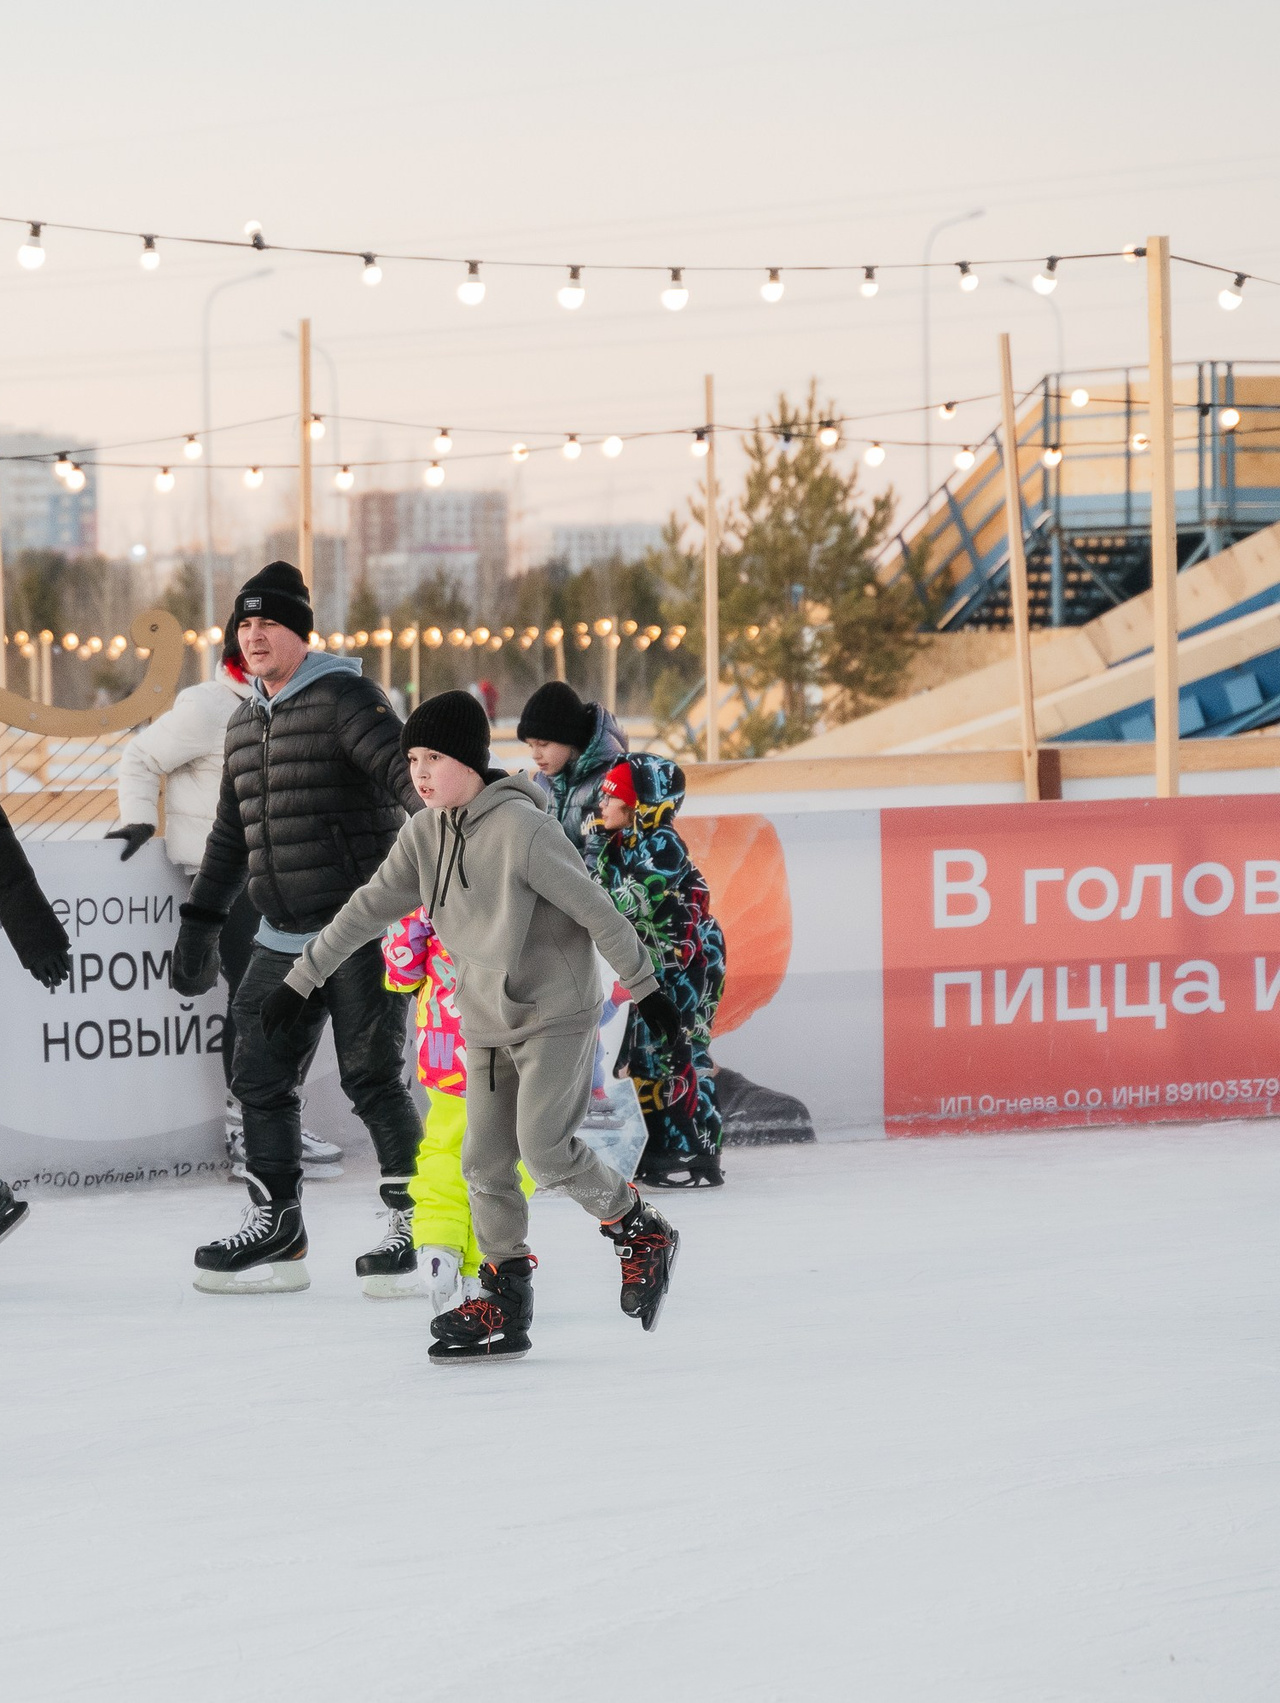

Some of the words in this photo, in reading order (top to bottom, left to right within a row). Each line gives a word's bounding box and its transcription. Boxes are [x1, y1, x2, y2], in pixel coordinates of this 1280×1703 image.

[933, 849, 991, 929] В
[933, 960, 1225, 1033] пицца
[42, 1003, 227, 1063] НОВЫЙ2
[940, 1095, 972, 1116] ИП
[978, 1094, 1058, 1115] Огнева
[1112, 1084, 1161, 1111] ИНН
